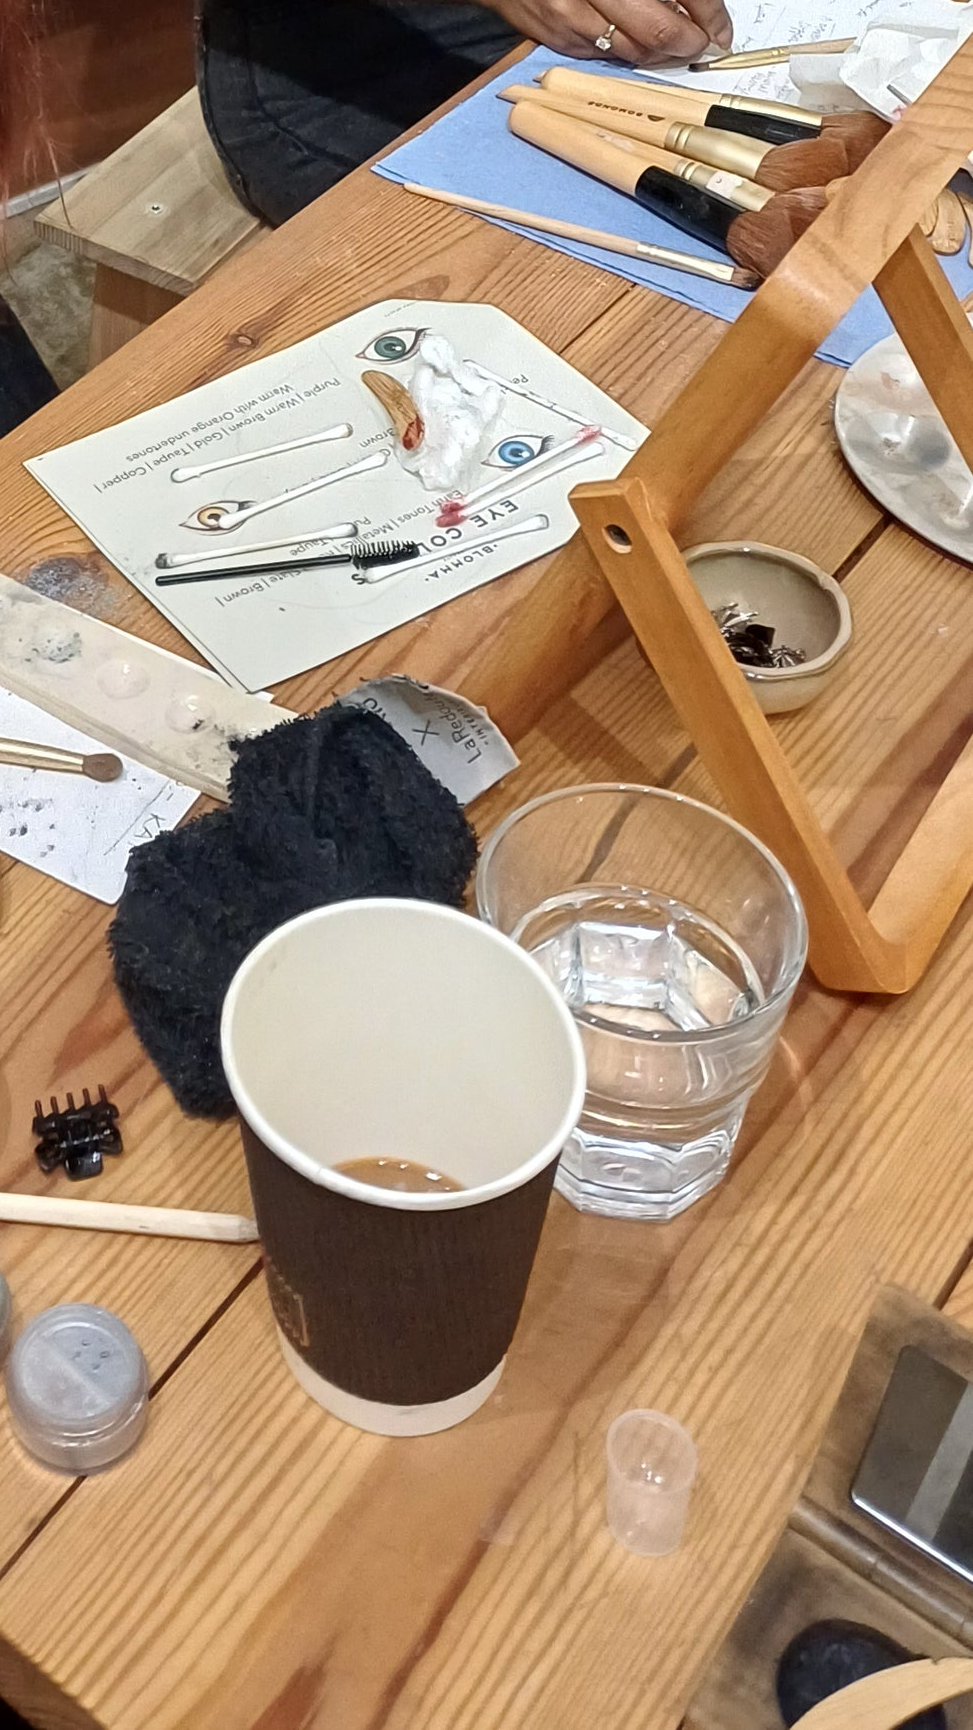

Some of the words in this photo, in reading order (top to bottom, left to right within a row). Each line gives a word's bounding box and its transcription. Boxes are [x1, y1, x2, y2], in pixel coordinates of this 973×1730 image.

[258, 384, 293, 403] Warm
[304, 377, 341, 398] Purple
[233, 399, 259, 415] with
[264, 397, 299, 416] Warm
[190, 411, 234, 434] Orange
[228, 412, 266, 432] Brown
[126, 430, 190, 462] undertones
[193, 431, 223, 450] Gold
[152, 447, 190, 467] Taupe
[103, 467, 147, 491] Copper
[397, 504, 435, 525] Tones
[470, 500, 518, 527] EYE
[351, 526, 462, 585] COLS
[223, 582, 265, 603] Brown
